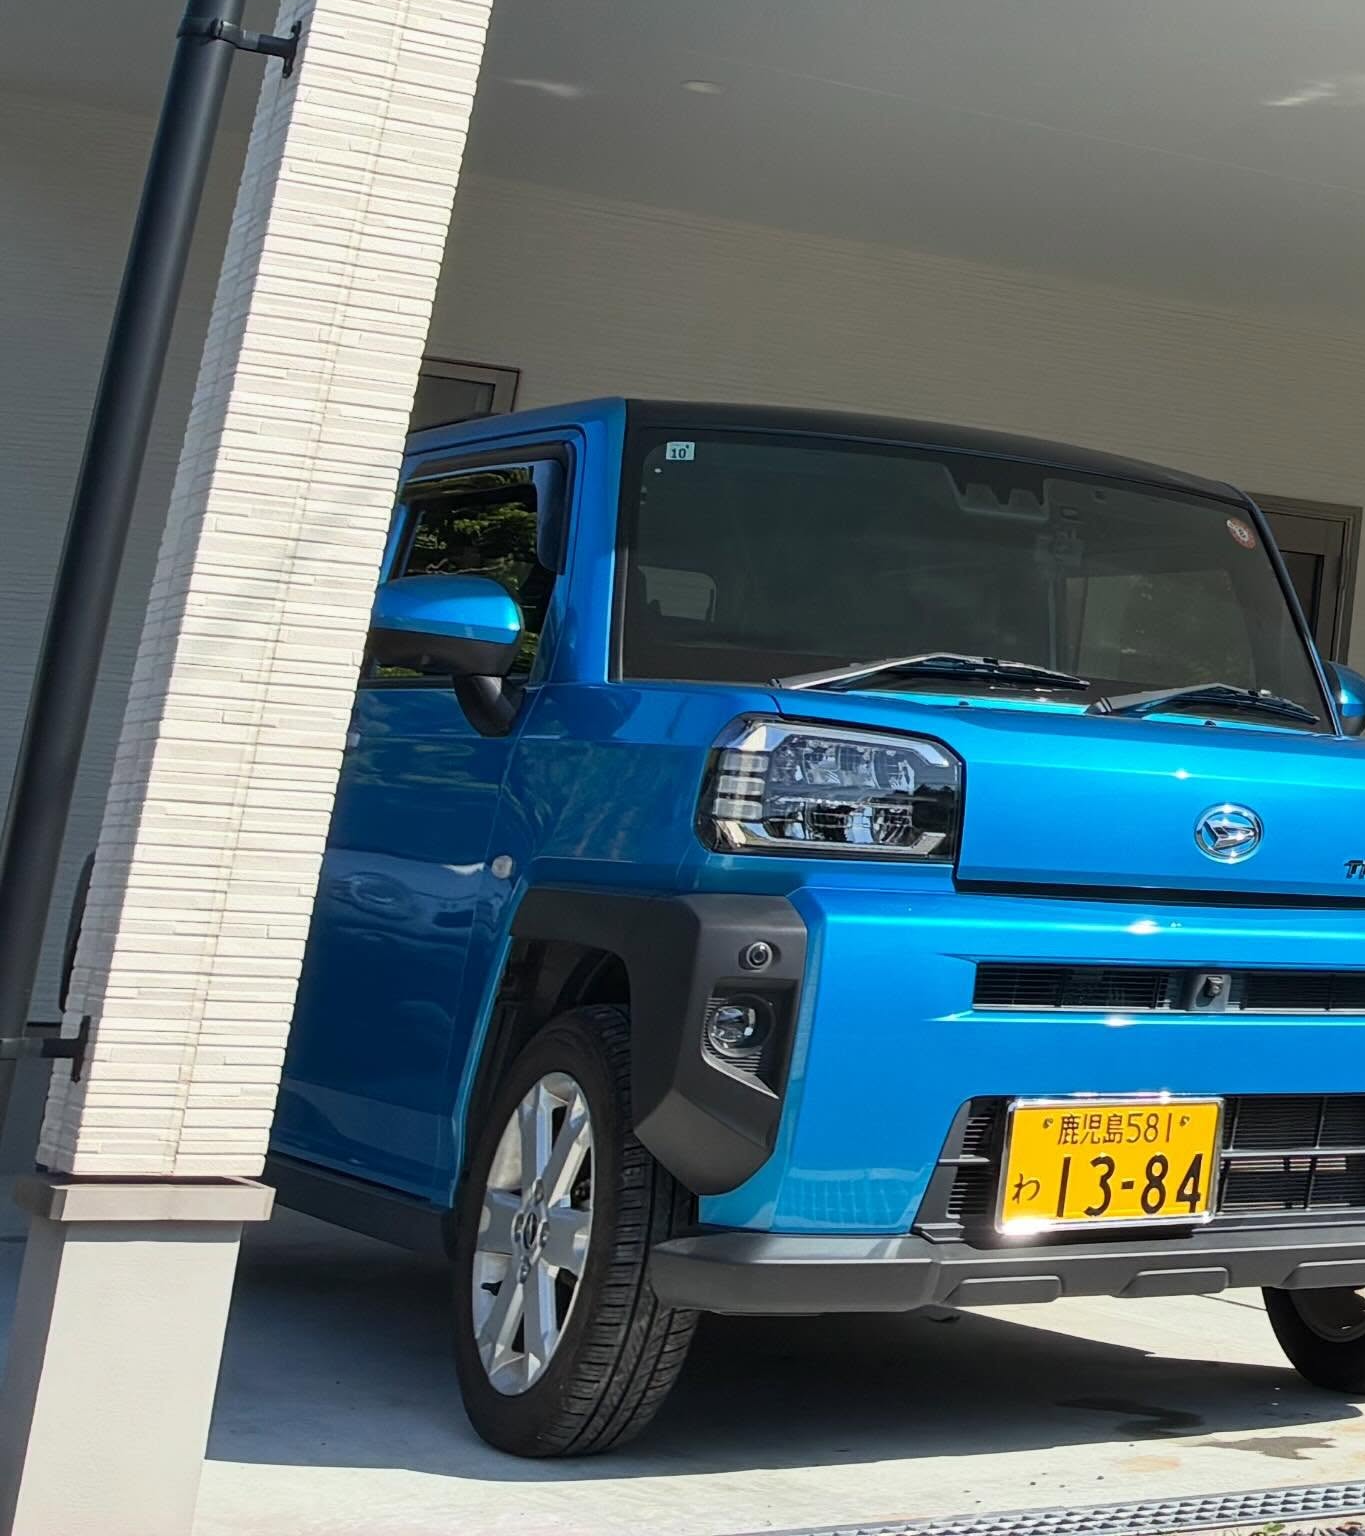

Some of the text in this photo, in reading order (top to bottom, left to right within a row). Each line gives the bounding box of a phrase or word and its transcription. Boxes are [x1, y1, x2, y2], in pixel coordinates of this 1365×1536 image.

[672, 448, 686, 459] 10
[1056, 1112, 1173, 1145] 鹿児島581
[1011, 1153, 1203, 1217] わ 13-84
